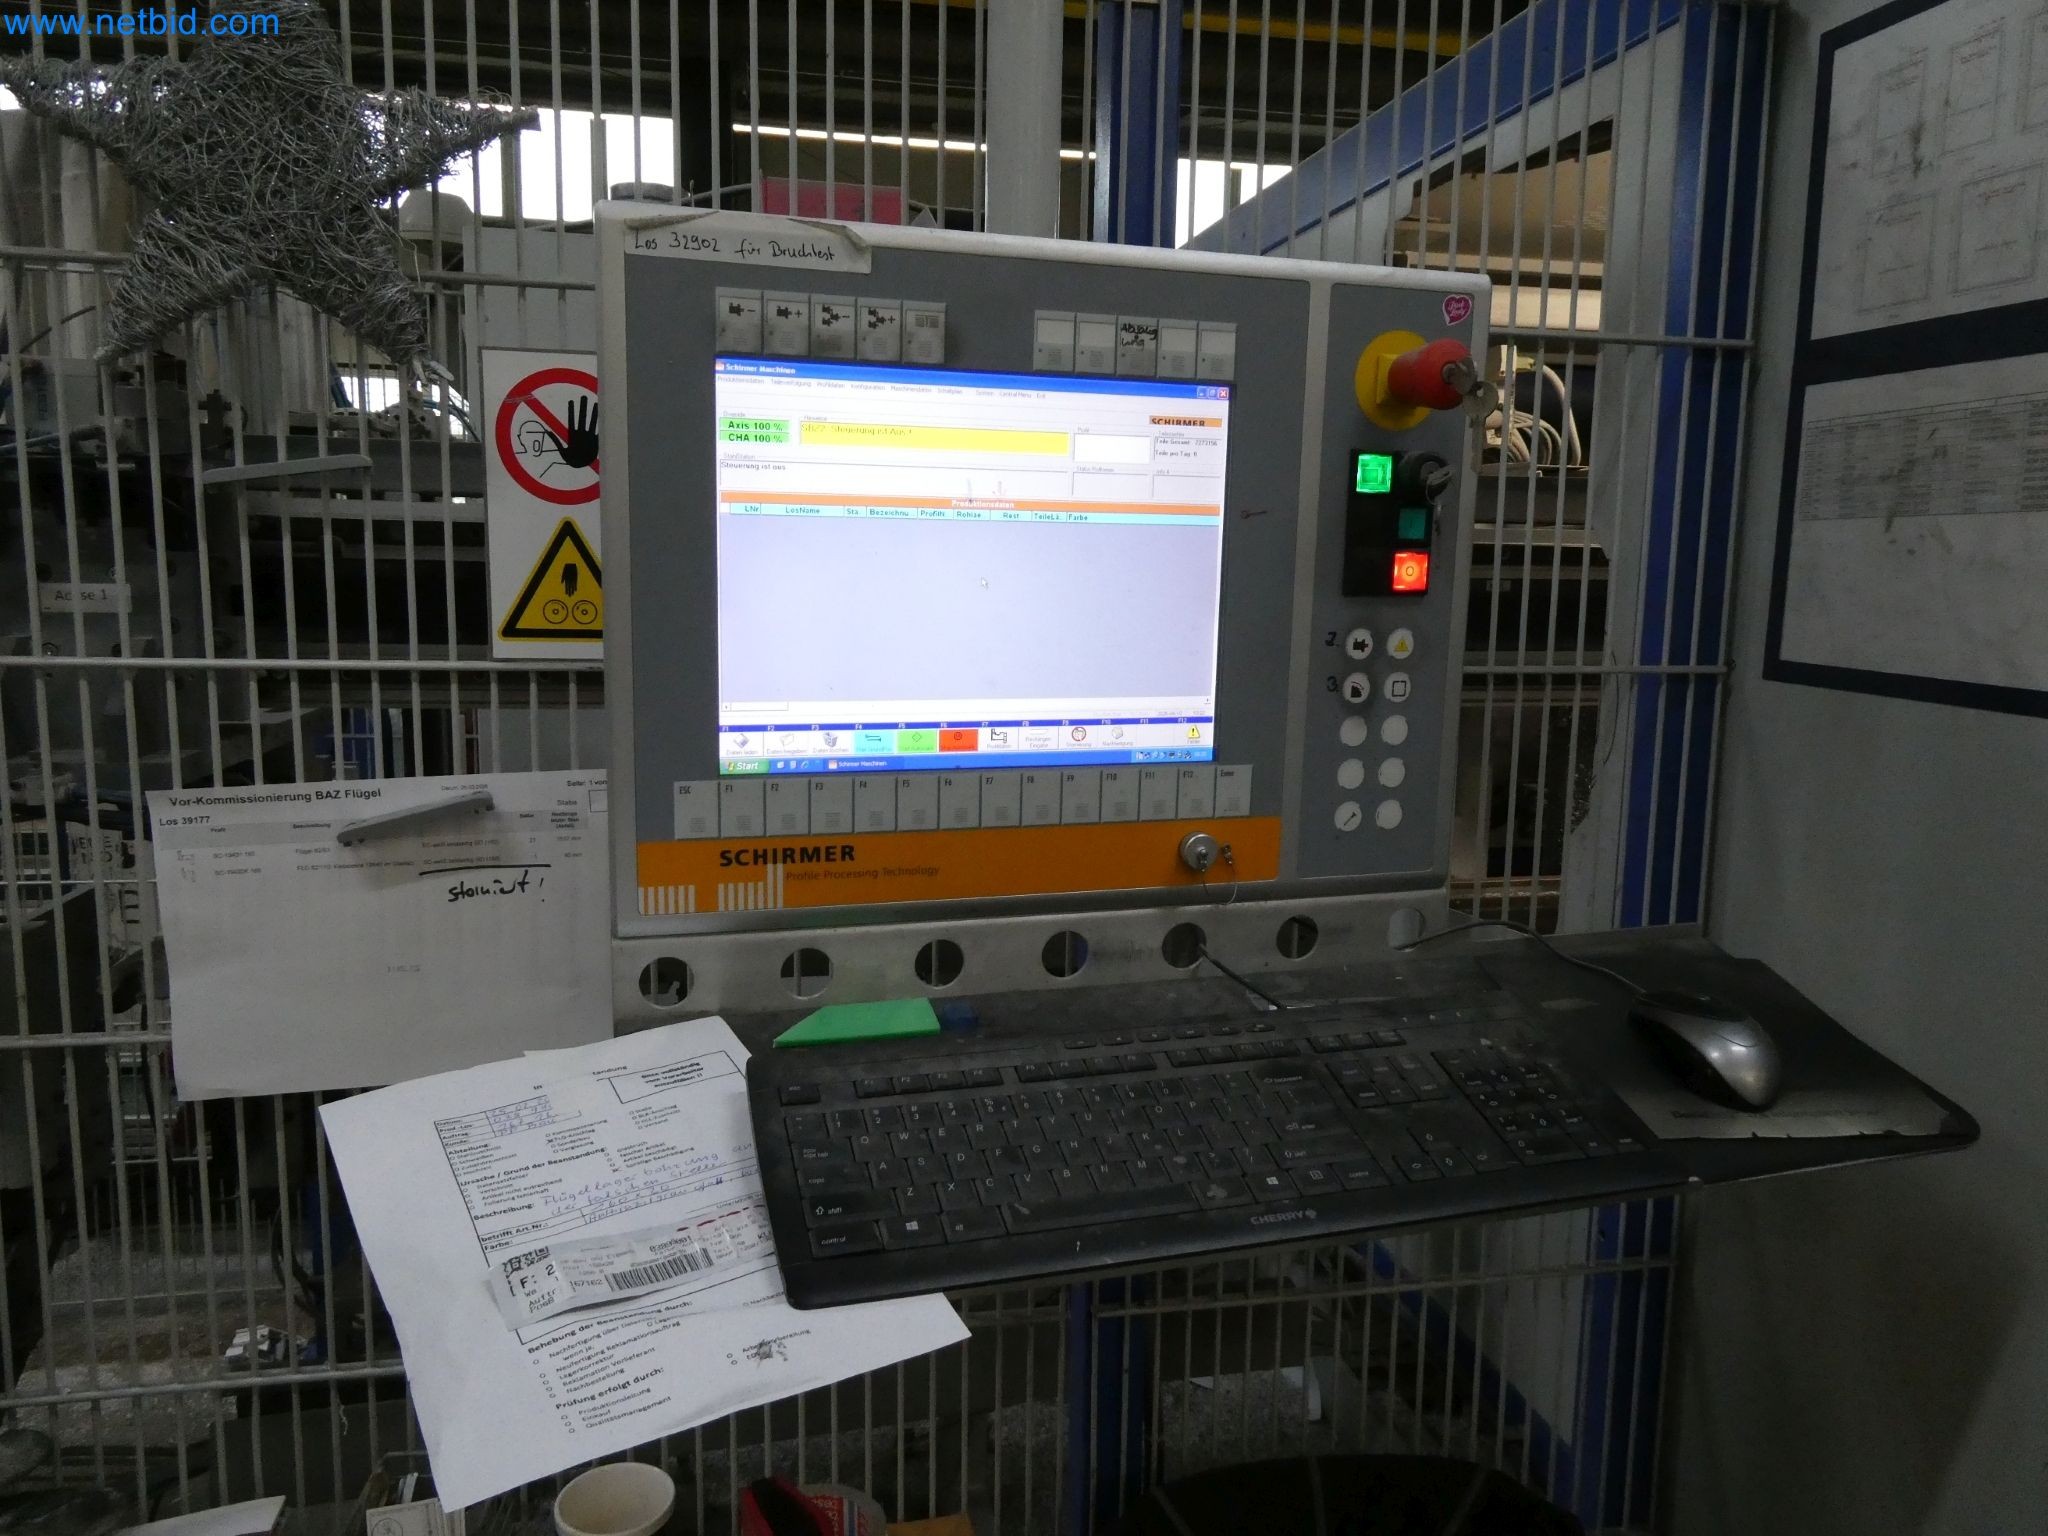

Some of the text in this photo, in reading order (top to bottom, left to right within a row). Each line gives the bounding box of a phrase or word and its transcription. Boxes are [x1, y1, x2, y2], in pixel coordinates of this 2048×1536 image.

[635, 229, 835, 261] Los 32902 für Bruchtest
[726, 363, 795, 374] Schirmer Maschinen
[728, 420, 782, 431] Axis 100 %
[1151, 418, 1205, 427] SCHIRMER
[728, 433, 782, 443] CHA 100 %
[721, 461, 759, 471] Steuerung
[952, 500, 1014, 509] Produktionsdaten
[55, 590, 96, 601] Acse
[736, 762, 759, 770] Start
[1027, 776, 1035, 784] F8
[1183, 770, 1194, 778] F12
[815, 783, 823, 791] F3
[903, 780, 911, 788] F5
[945, 778, 952, 787] F6
[679, 786, 691, 795] ESC
[726, 785, 733, 793] F1
[170, 788, 381, 807] Vor-Kommissionierung BAZ Flügel
[160, 816, 210, 826] Los 39177
[720, 845, 855, 866] SCHIRMER
[786, 866, 939, 881] Profile Processing Technology
[460, 1174, 495, 1187] Ursache
[504, 1165, 530, 1177] Grund
[548, 1147, 607, 1165] Beanstandung:
[474, 1202, 535, 1220] Beschreibung:
[1251, 1211, 1304, 1225] CHERRY
[481, 1229, 513, 1242] betrifft
[821, 1236, 847, 1246] control
[484, 1240, 514, 1251] Farbe:
[546, 1264, 556, 1277] 2
[528, 1330, 577, 1354] Behebung
[578, 1324, 594, 1333] der
[664, 1300, 693, 1313] durch:
[549, 1334, 601, 1358] Nachfertigung
[556, 1320, 681, 1373] Neufertigung Reklamationsauftrag
[563, 1350, 585, 1361] wenn
[559, 1353, 615, 1380] Lagerkorrektur
[562, 1347, 655, 1387] Reklamation Vorlieferant
[566, 1366, 625, 1395] Nachbestellung
[556, 1367, 664, 1410] Prüfung erfolgt durch:
[578, 1387, 652, 1415] Produktionsleitung
[582, 1408, 611, 1422] Einkauf
[586, 1396, 672, 1429] Qualitätsmanagement
